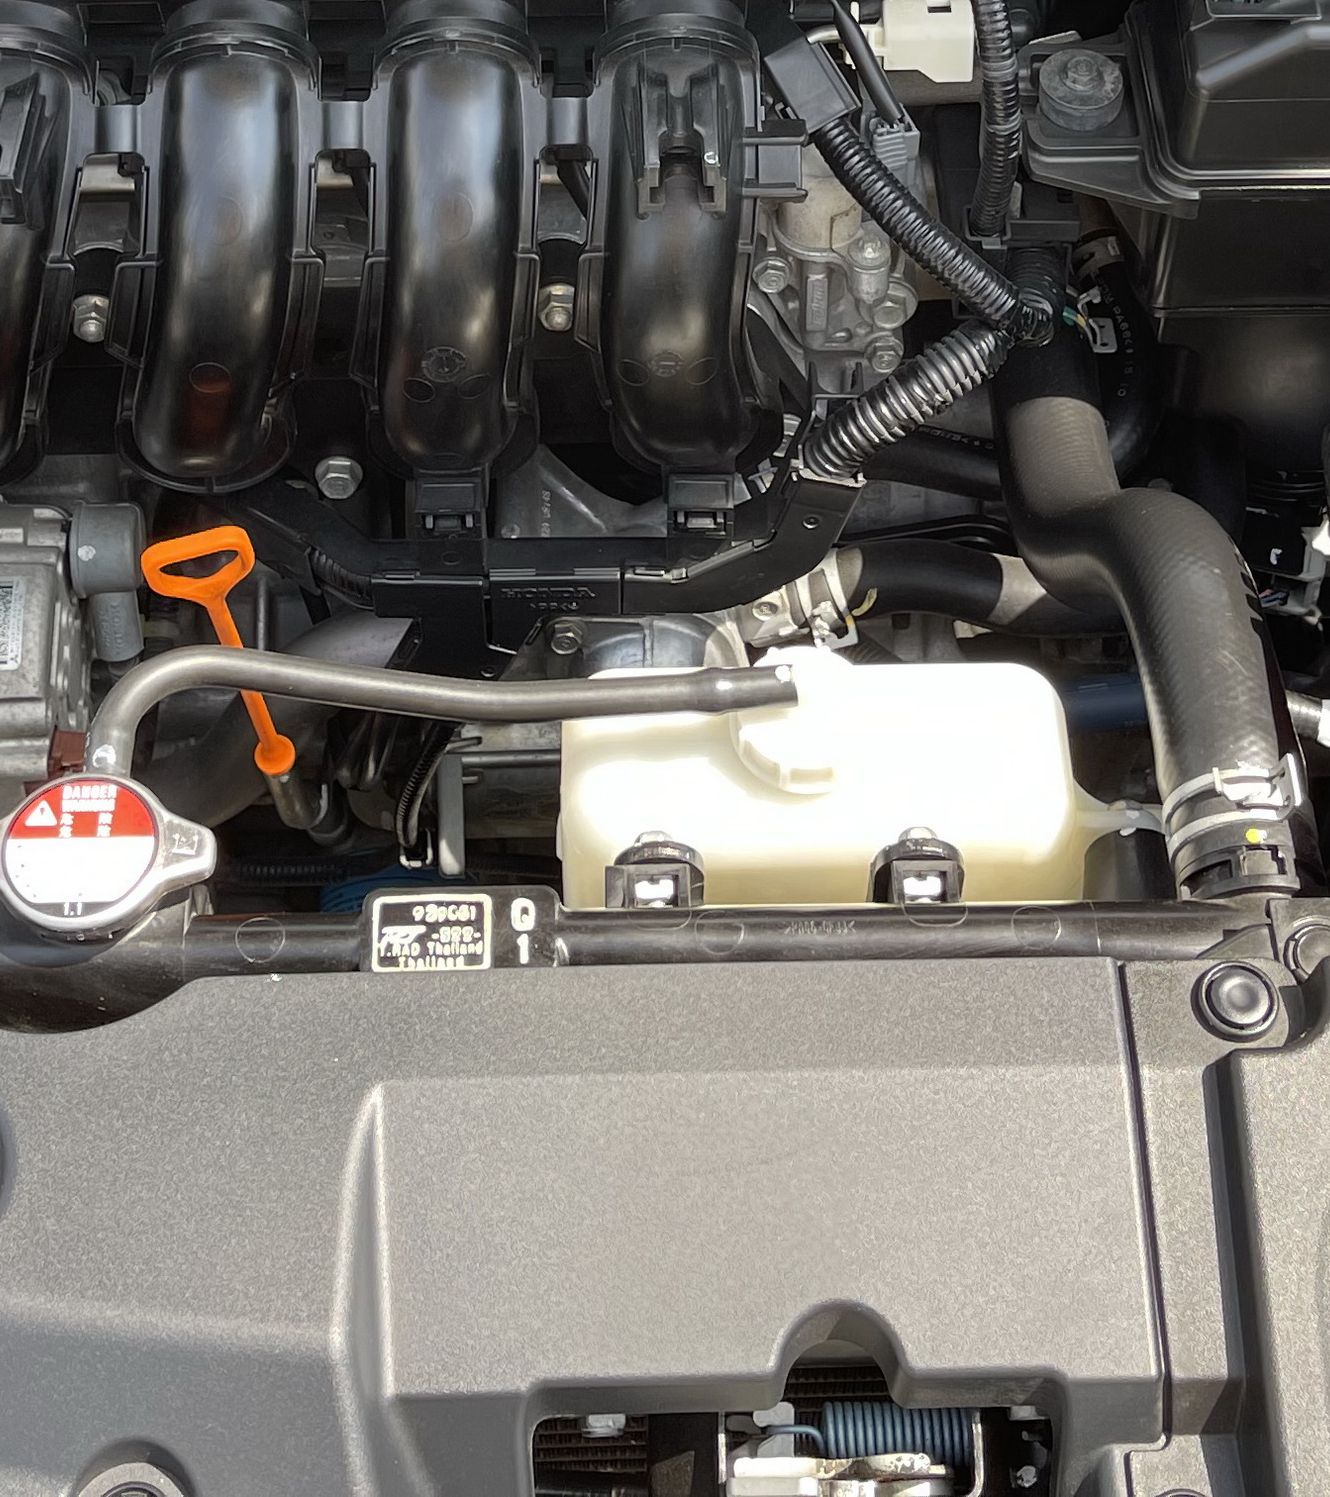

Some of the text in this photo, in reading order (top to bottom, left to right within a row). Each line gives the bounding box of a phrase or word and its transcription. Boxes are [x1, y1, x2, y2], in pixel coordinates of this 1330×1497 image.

[62, 784, 118, 800] DANGER
[63, 902, 83, 916] 1.1
[427, 940, 484, 956] Thailand
[516, 933, 530, 965] 1
